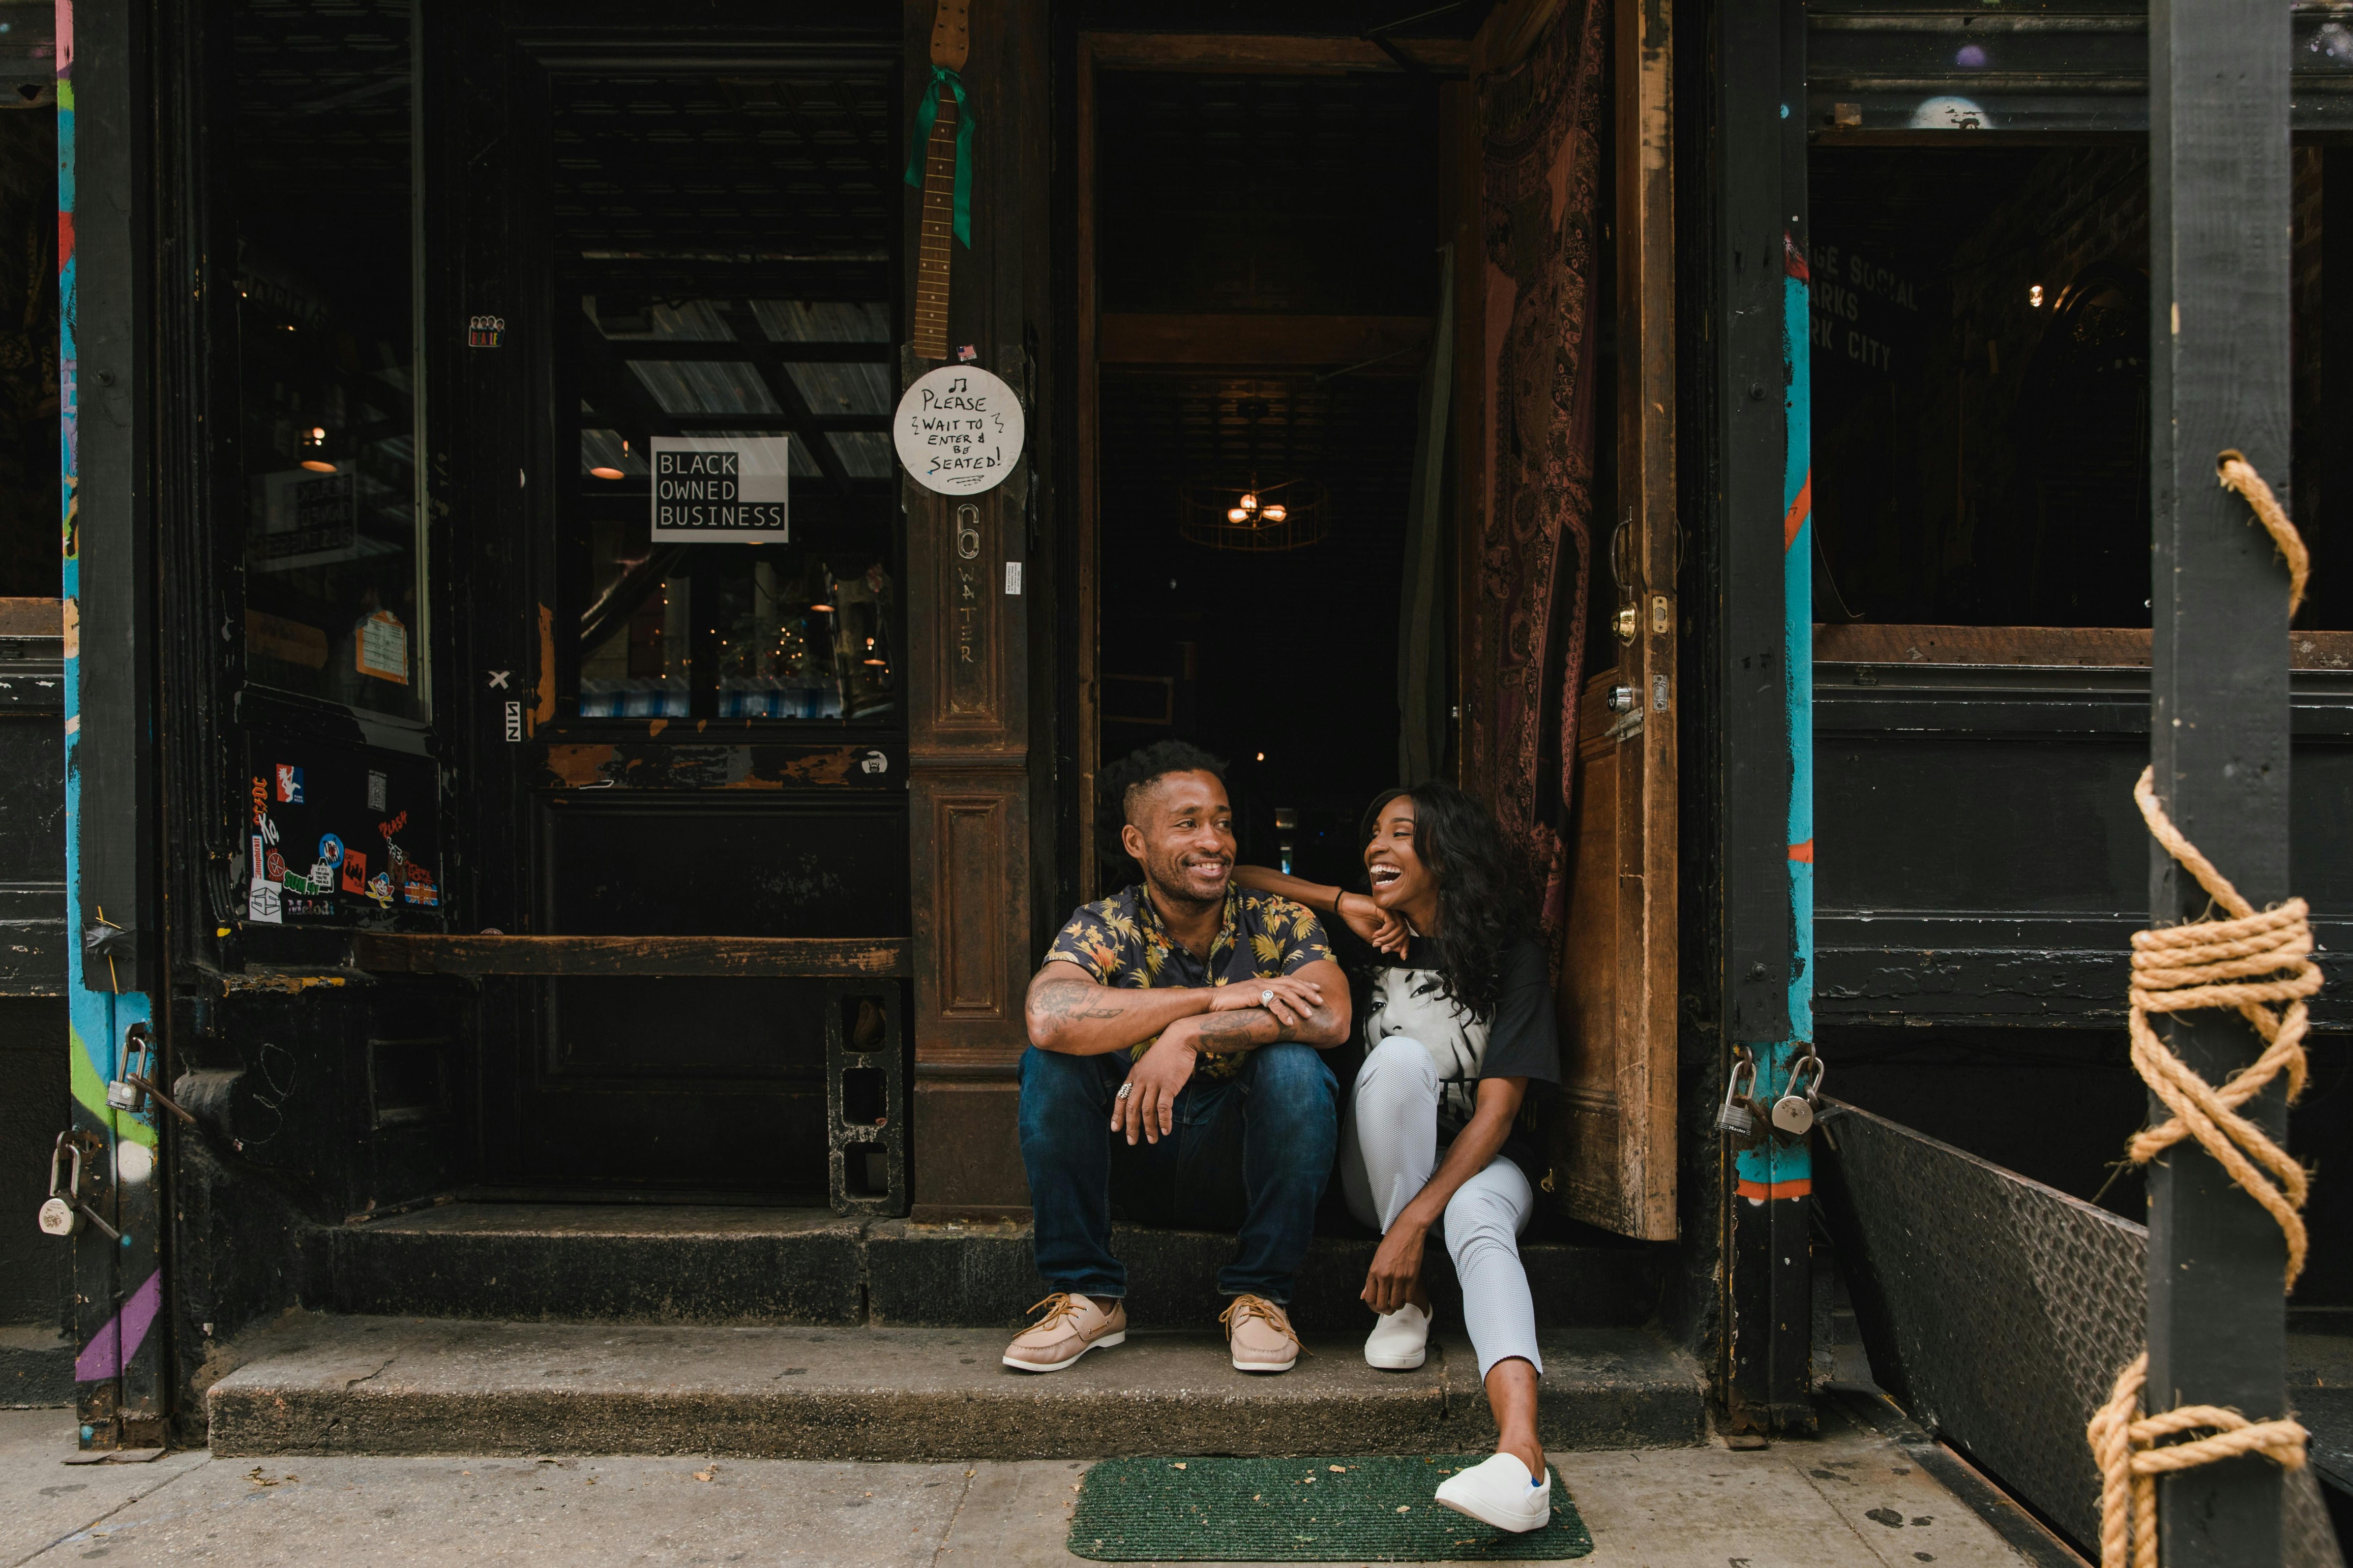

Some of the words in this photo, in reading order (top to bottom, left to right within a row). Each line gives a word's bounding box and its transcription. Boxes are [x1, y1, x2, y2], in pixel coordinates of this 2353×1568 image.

[1809, 246, 1839, 276] GE
[1850, 255, 1918, 312] SOCIAL
[1849, 331, 1891, 372] CITY
[921, 389, 987, 411] PLEASE
[922, 417, 960, 432] WAIT
[966, 418, 983, 430] TO
[928, 435, 972, 445] ENTER
[953, 445, 971, 454] BE
[661, 455, 736, 474] BLACK
[930, 446, 1001, 472] SEATED!
[660, 480, 735, 500] OWNED
[661, 506, 781, 526] BUSINESS
[957, 503, 979, 559] 6
[508, 703, 518, 740] NIN
[285, 870, 306, 895] SUM
[109, 1101, 126, 1109] Master
[1728, 1125, 1746, 1134] Master
